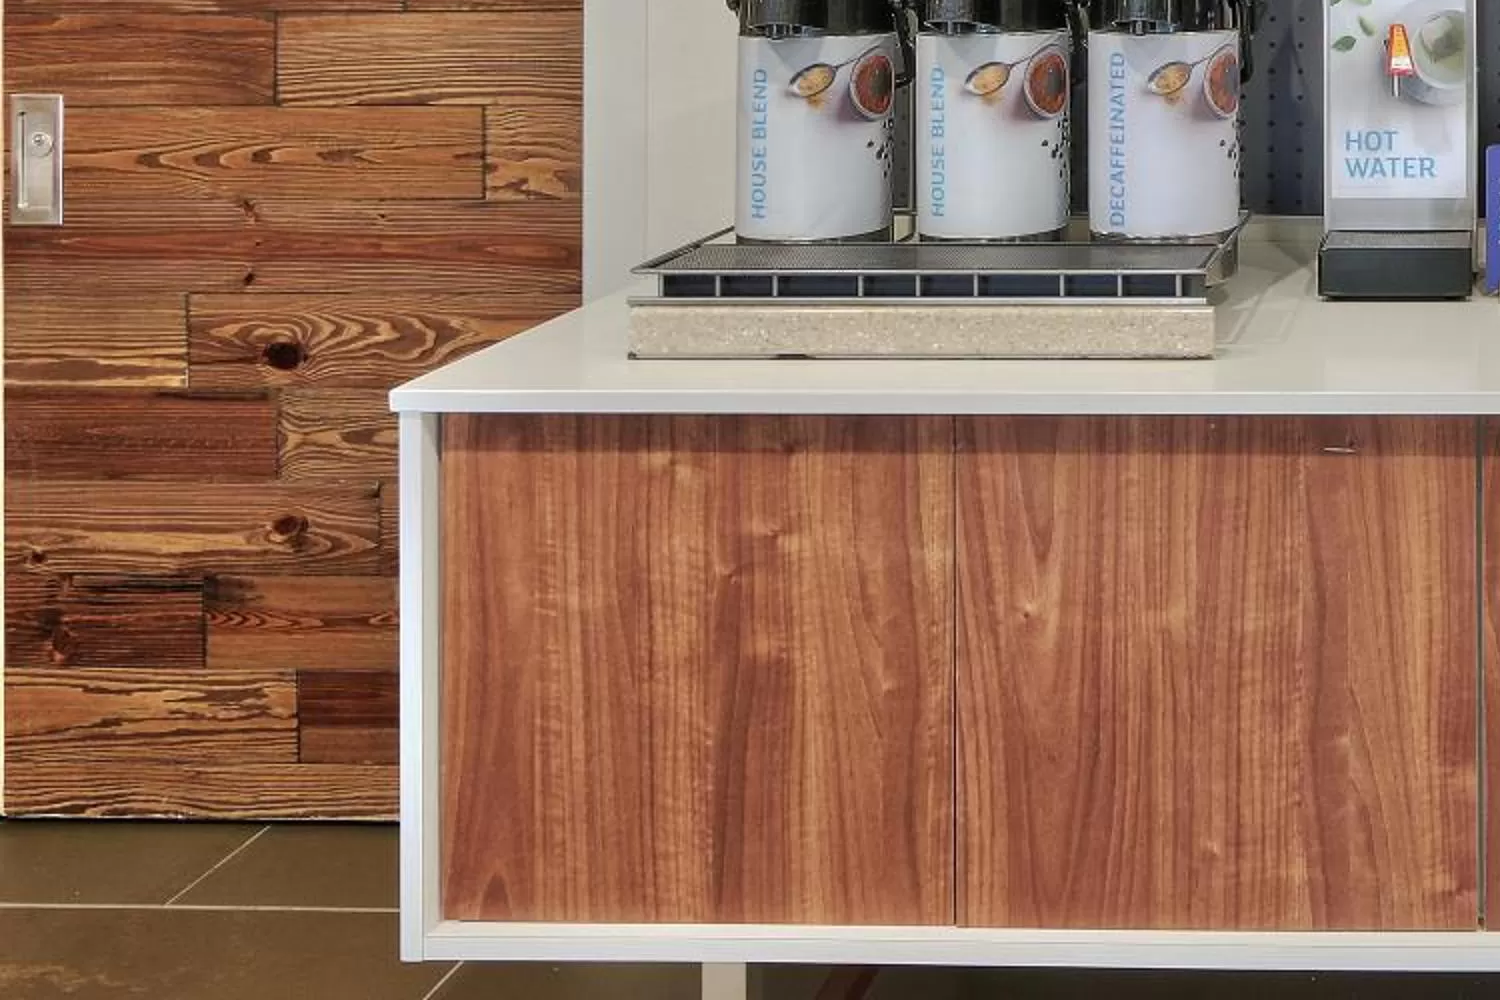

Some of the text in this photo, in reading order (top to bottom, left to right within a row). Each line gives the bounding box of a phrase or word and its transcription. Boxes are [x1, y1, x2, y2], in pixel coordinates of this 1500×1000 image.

[752, 68, 768, 220] HOUSE BLEND
[931, 67, 945, 217] HOUSE BLEND
[1109, 52, 1125, 227] DECAFFEINATED
[1344, 157, 1438, 179] WATER
[1345, 130, 1399, 152] HOT
